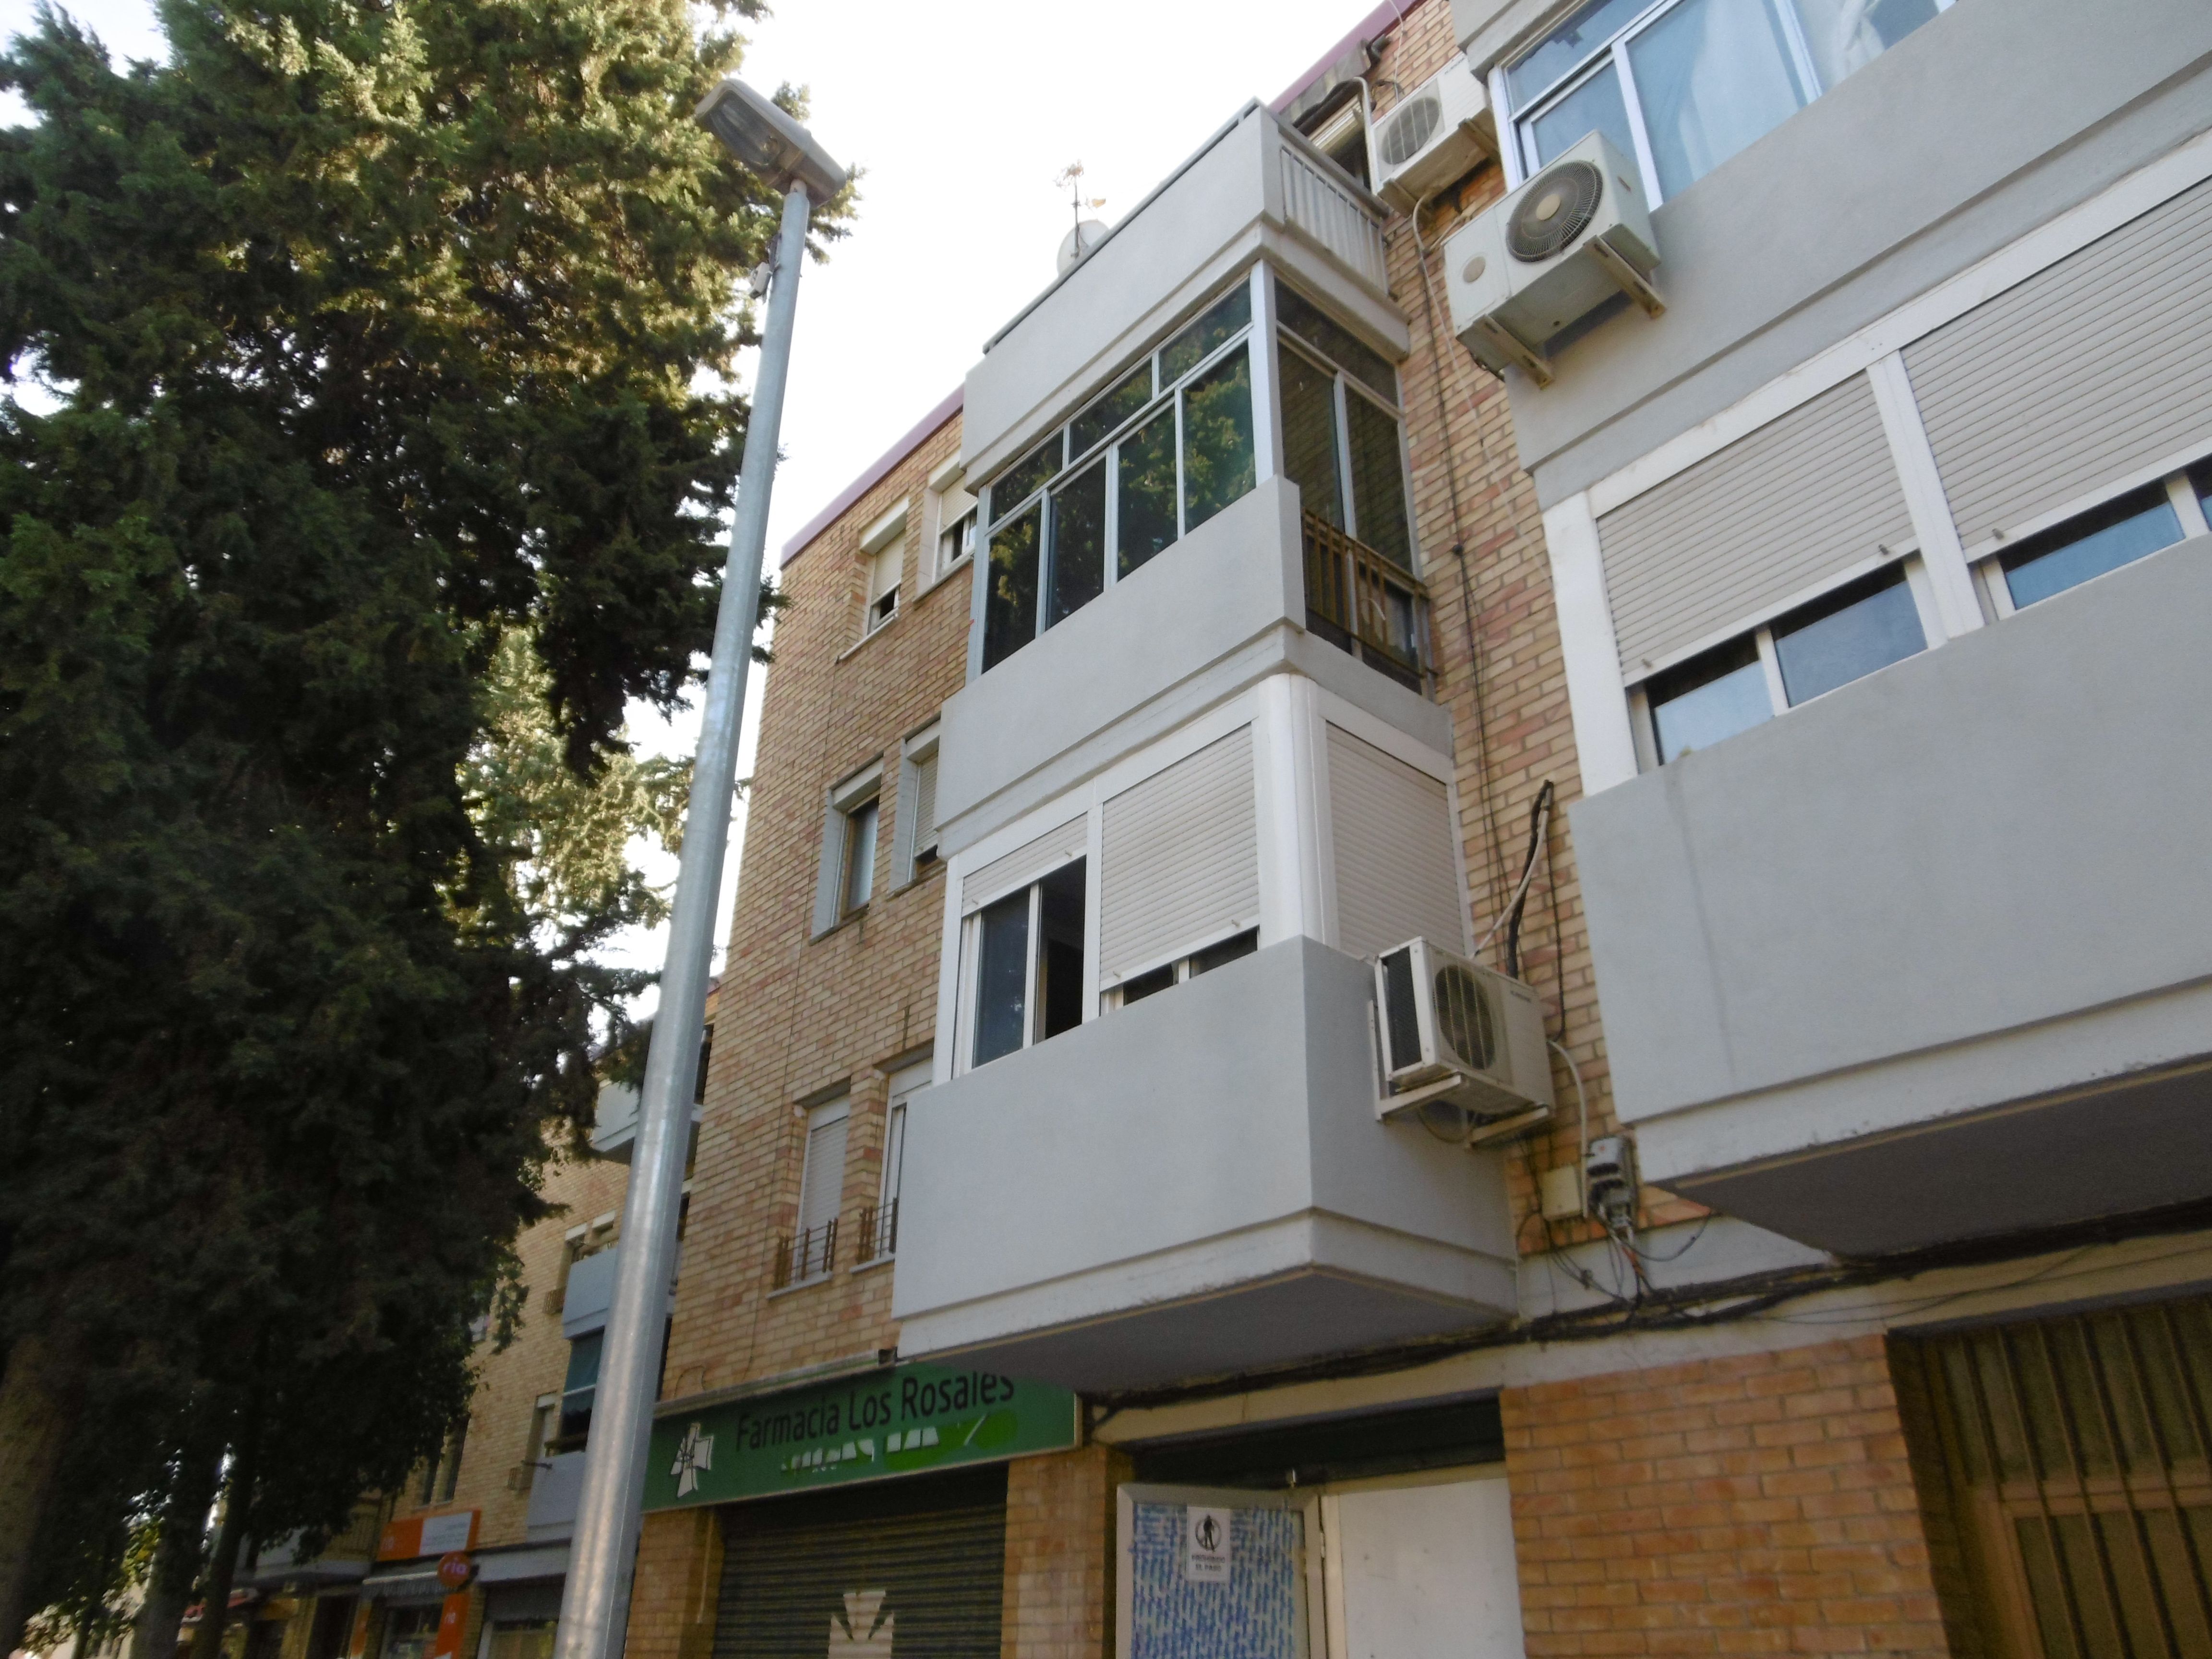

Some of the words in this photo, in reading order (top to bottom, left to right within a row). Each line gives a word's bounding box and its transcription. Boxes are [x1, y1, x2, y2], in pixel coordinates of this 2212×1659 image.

[849, 1391, 892, 1431] Los
[900, 1371, 1014, 1421] Rosales
[443, 1557, 468, 1575] ria
